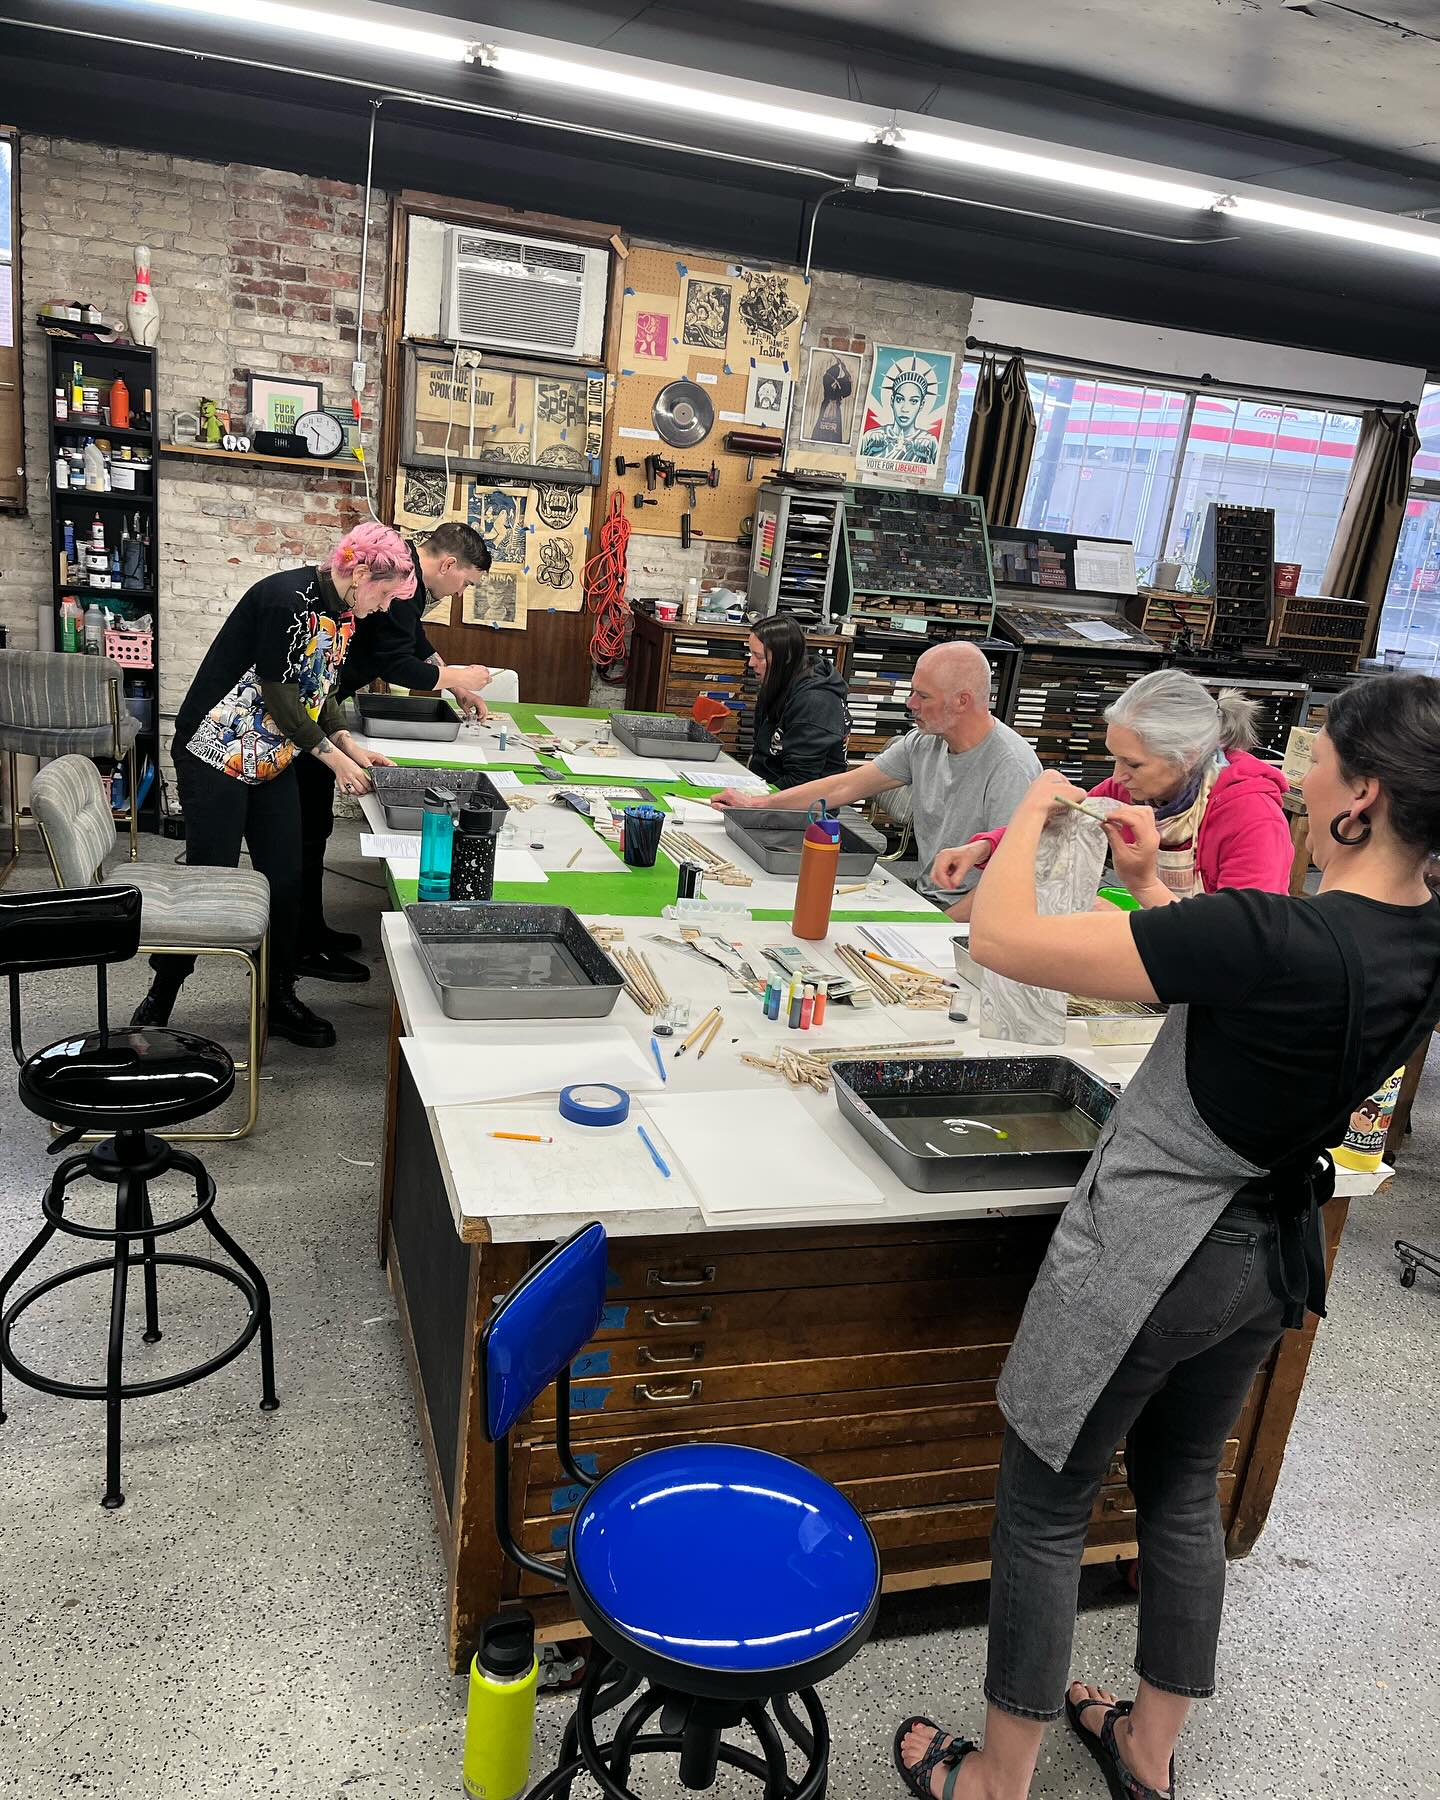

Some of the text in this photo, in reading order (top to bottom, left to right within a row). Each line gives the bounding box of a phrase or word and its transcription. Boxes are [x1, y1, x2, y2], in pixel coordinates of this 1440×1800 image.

[588, 380, 603, 407] SOUTH
[274, 403, 295, 415] FUCK
[274, 413, 295, 425] YOUR
[274, 423, 295, 435] GUNS
[586, 432, 602, 455] GANG
[866, 459, 928, 475] VOTE FOR LIBERATION
[582, 1357, 592, 1372] 3
[574, 1391, 588, 1409] 4
[568, 1487, 579, 1502] 6
